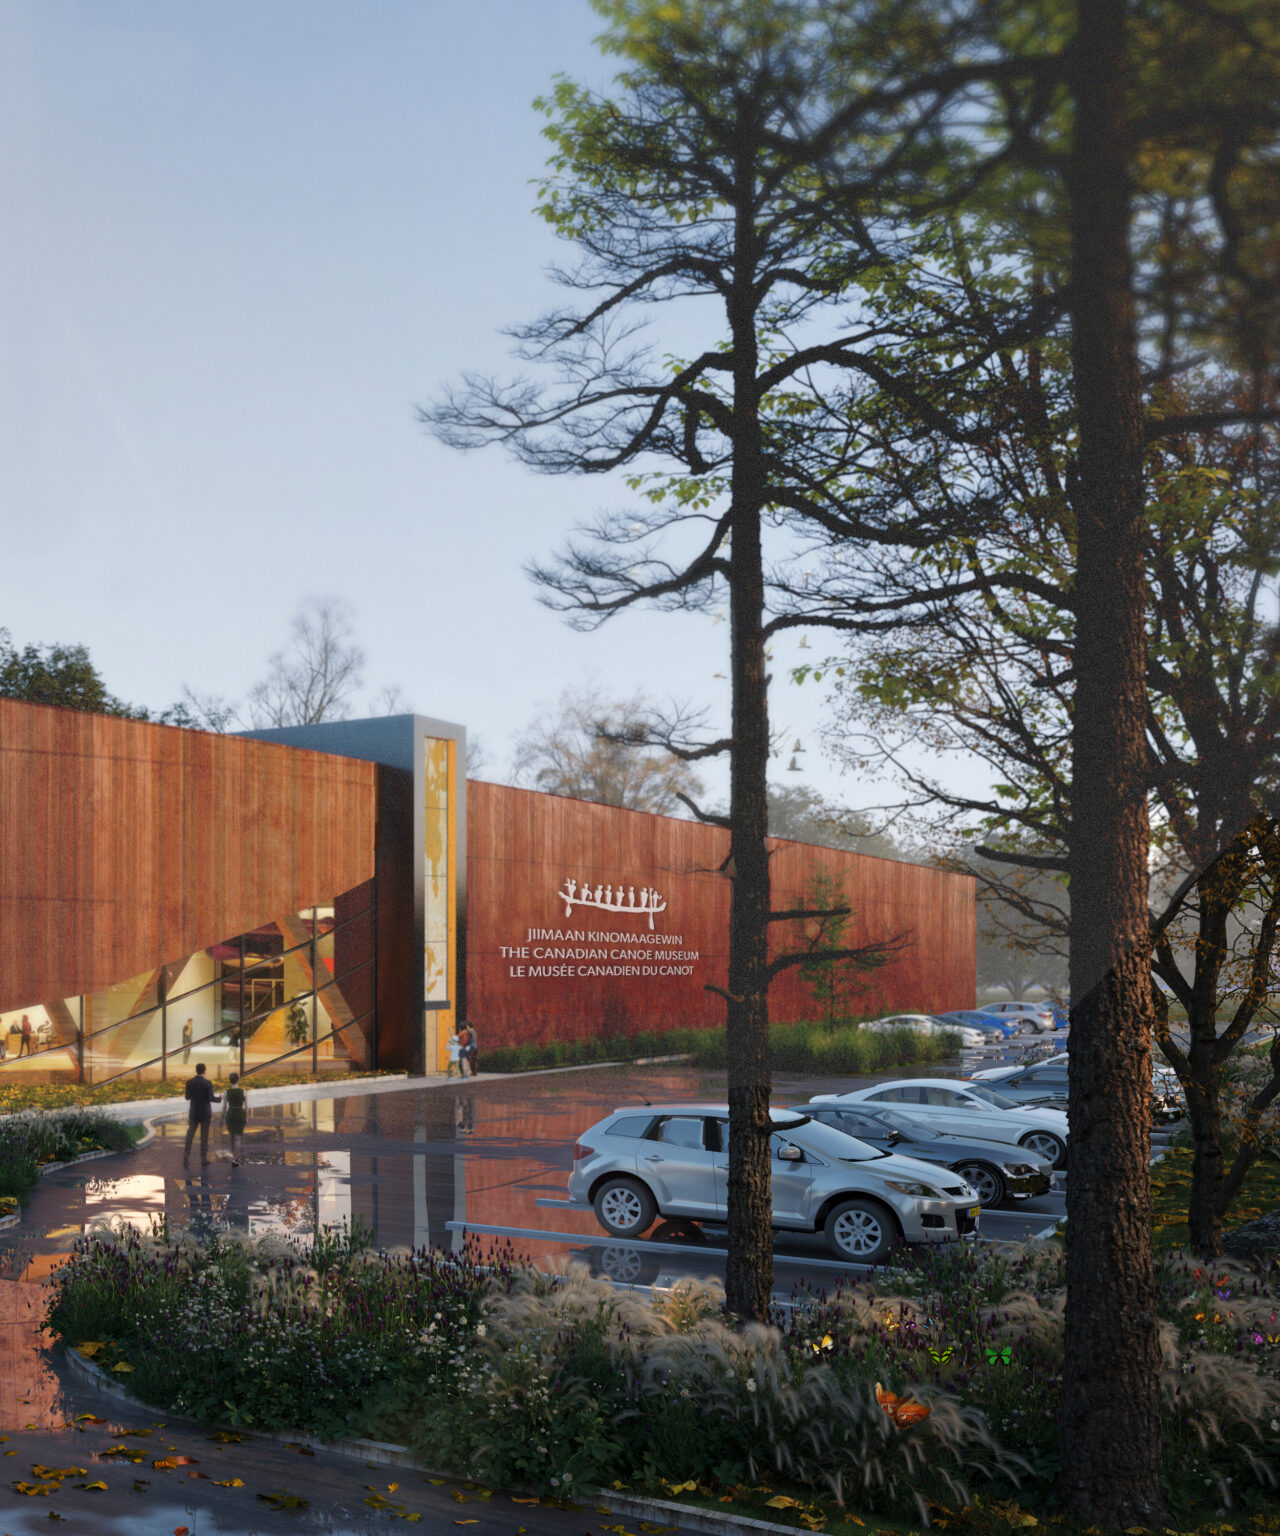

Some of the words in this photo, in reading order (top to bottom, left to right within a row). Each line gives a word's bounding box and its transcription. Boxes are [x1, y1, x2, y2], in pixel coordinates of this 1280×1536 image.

[527, 928, 585, 943] JIIMAAN
[588, 931, 683, 945] KINOMAAGEWIN
[499, 946, 530, 959] THE
[533, 947, 608, 960] CANADIAN
[610, 949, 653, 960] CANOE
[654, 950, 700, 961] MUSEUM
[510, 965, 526, 977] LE
[528, 963, 575, 977] MUSÉE
[577, 965, 640, 976] CANADIEN
[642, 965, 658, 976] DU
[659, 965, 695, 976] CANOT
